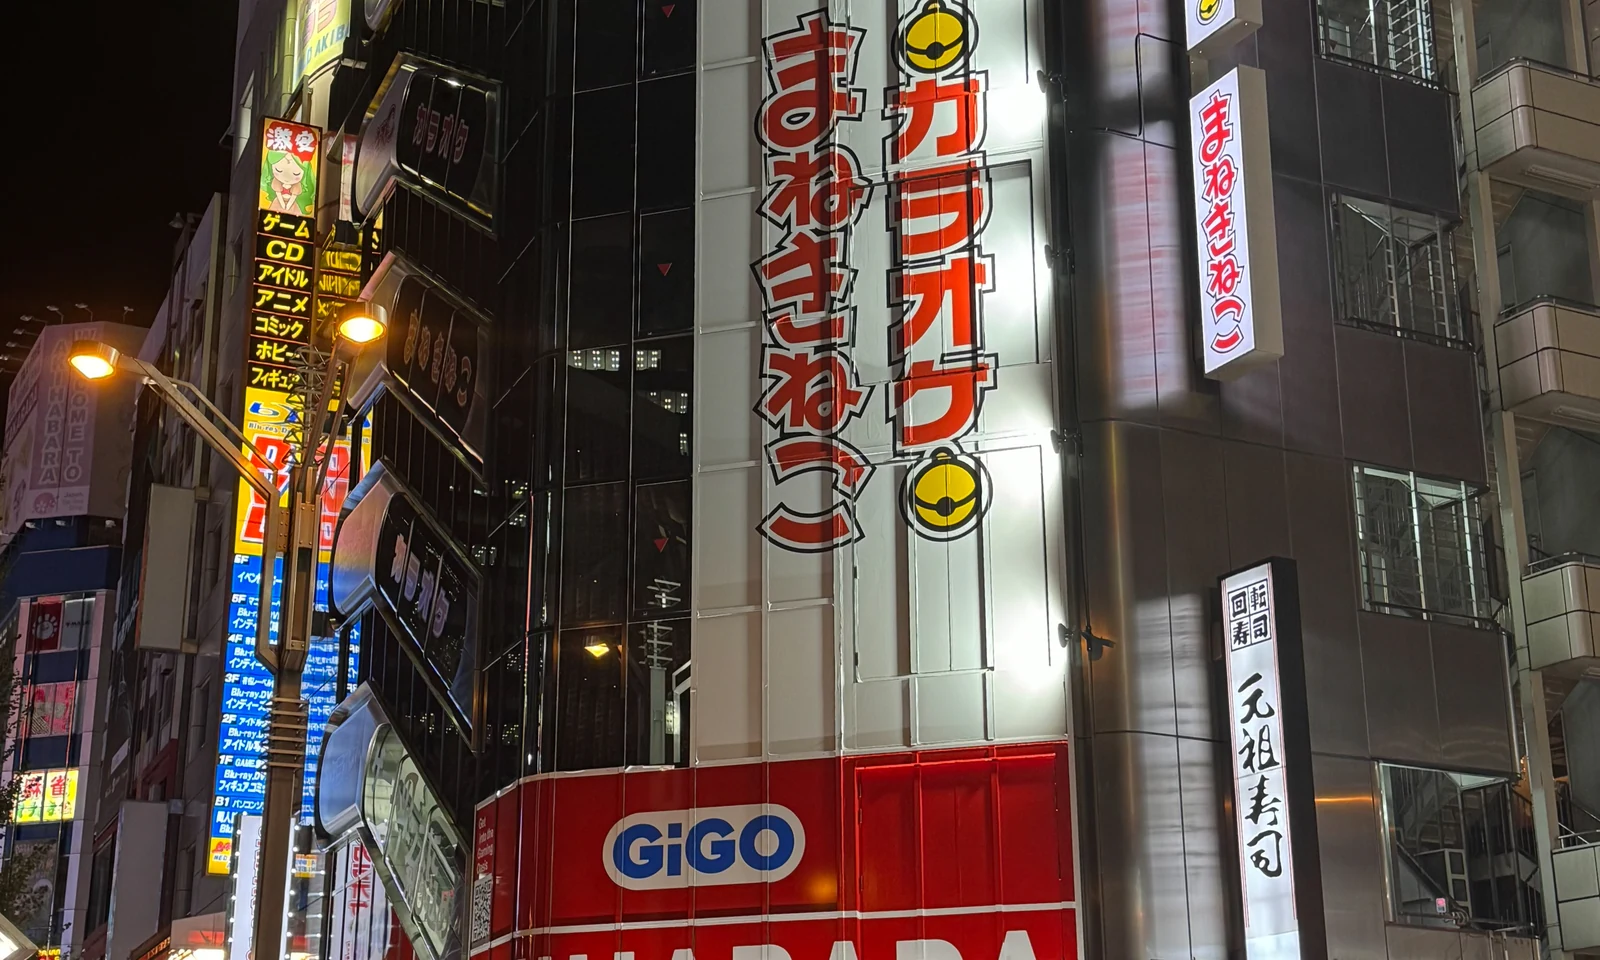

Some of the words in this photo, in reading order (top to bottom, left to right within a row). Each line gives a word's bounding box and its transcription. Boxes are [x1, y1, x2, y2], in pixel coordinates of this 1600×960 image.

[266, 126, 315, 153] 激安
[263, 213, 310, 239] ゲーム
[1197, 89, 1245, 354] まねきねこ
[265, 240, 305, 262] CD
[883, 70, 998, 457] カラオケ
[258, 263, 309, 288] アイドル
[750, 7, 876, 554] まねきねこ
[255, 289, 309, 314] アニメ
[255, 315, 304, 339] コミック
[255, 340, 300, 363] ホビー
[228, 634, 243, 644] 4F
[224, 673, 240, 683] 3F
[221, 714, 237, 724] 2F
[219, 754, 234, 765] 1F
[1237, 671, 1284, 879] 元祖寿司
[214, 796, 230, 807] B1
[612, 814, 795, 879] GiGO
